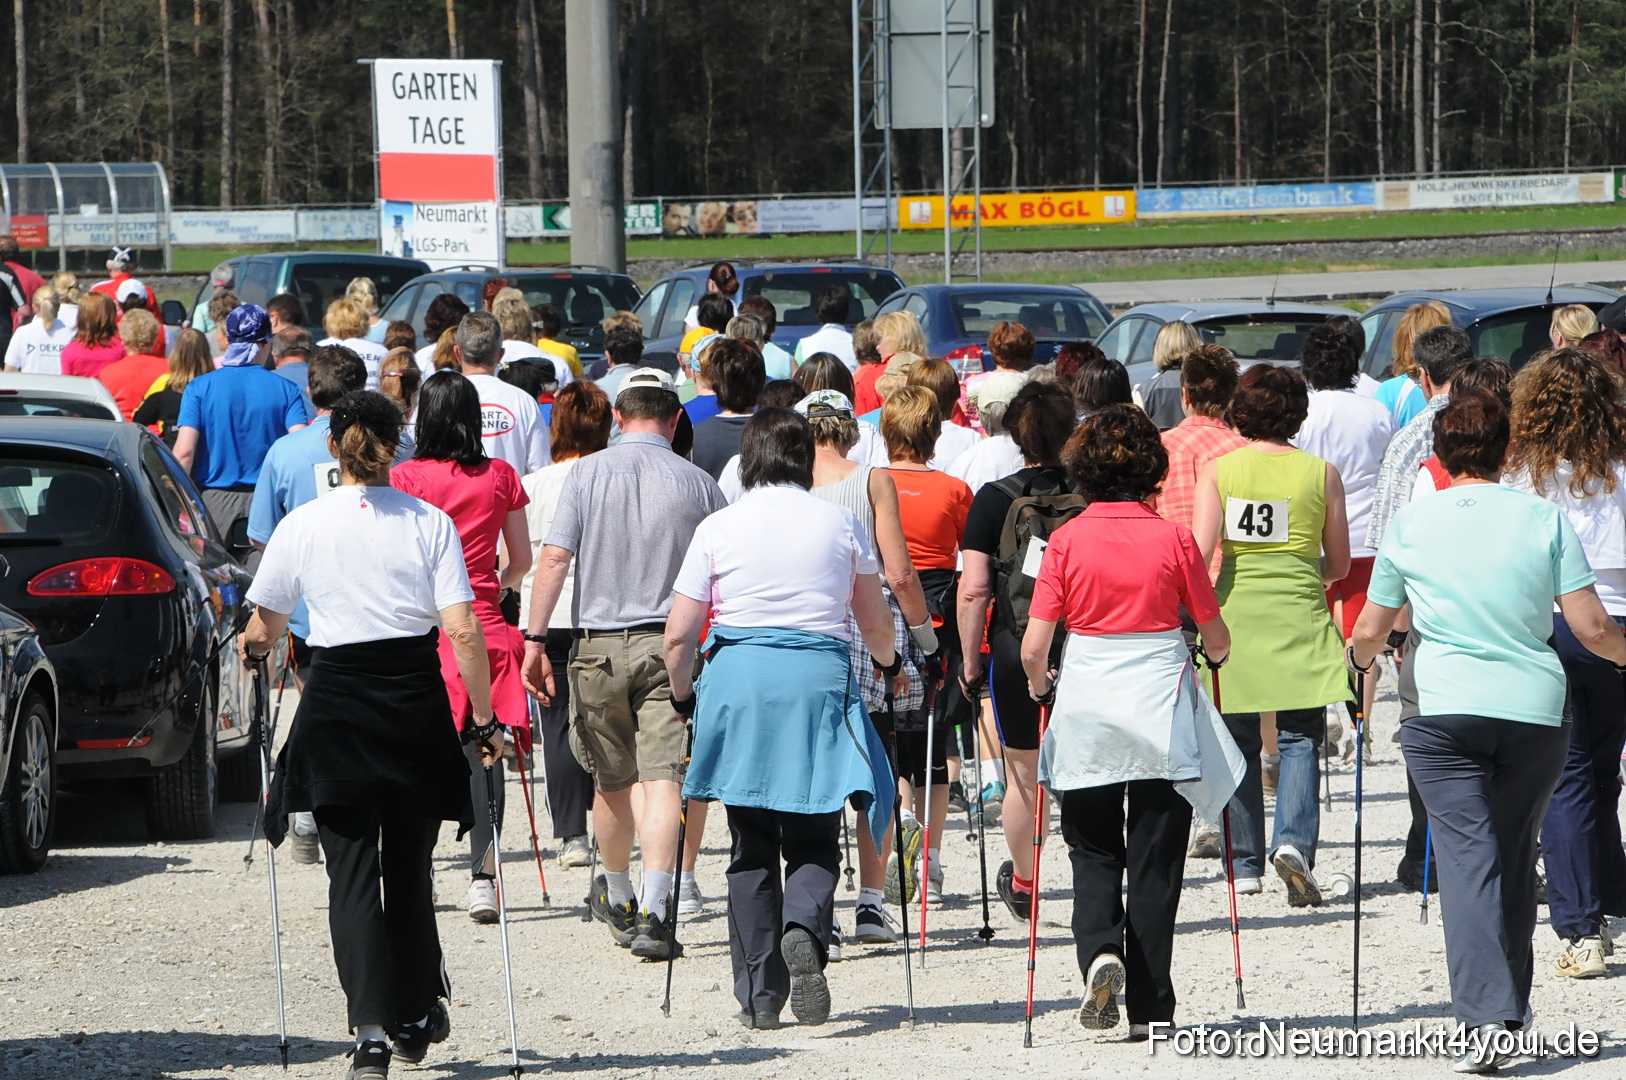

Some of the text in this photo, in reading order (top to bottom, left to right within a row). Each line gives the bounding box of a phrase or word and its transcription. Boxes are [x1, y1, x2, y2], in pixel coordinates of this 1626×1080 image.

[392, 72, 478, 101] GARTEN
[408, 116, 466, 145] TAGE
[416, 204, 488, 223] Neumarkt
[950, 196, 1090, 221] MAX BÖGL
[416, 237, 471, 254] LGS-Park
[1237, 503, 1274, 537] 43
